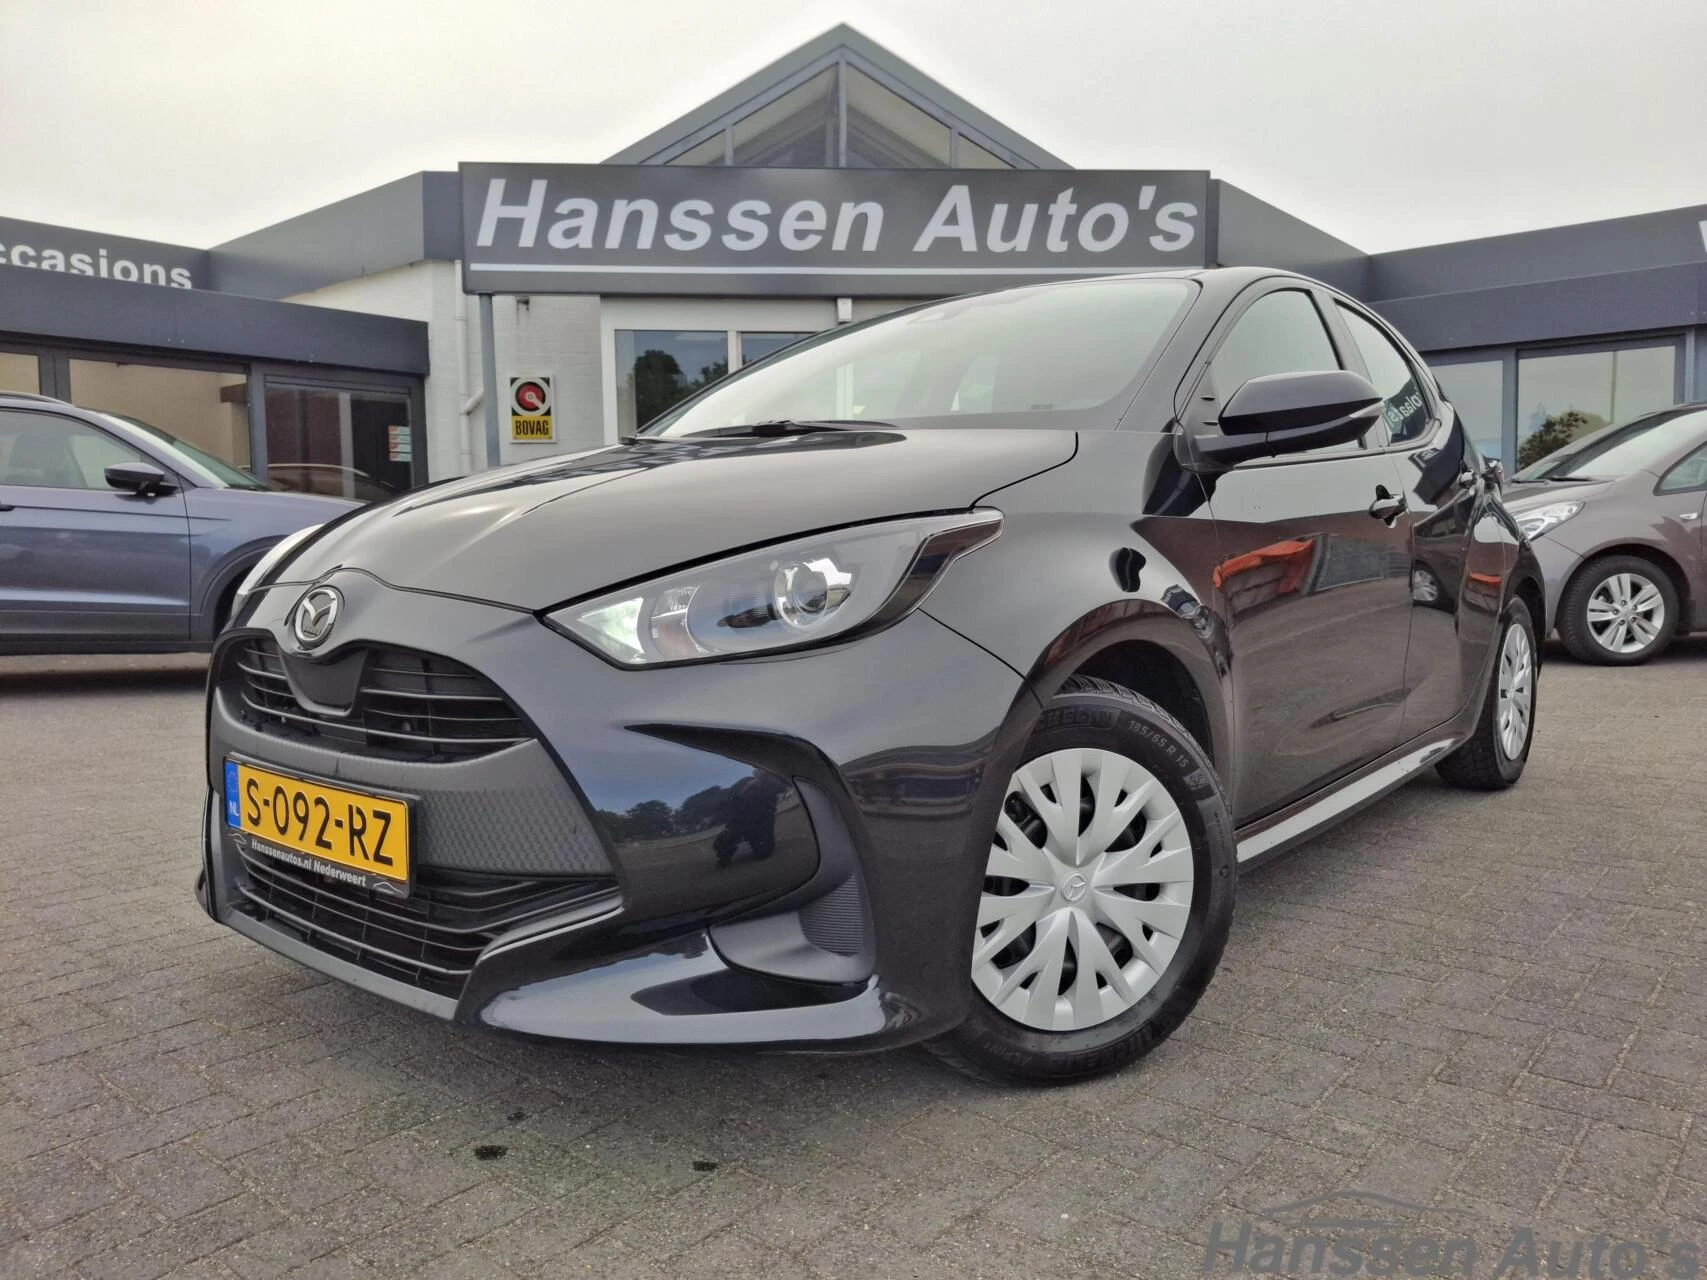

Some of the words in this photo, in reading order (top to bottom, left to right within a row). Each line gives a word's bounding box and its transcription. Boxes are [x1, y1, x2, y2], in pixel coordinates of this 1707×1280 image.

[476, 178, 884, 252] Hanssen
[912, 184, 1198, 253] Auto's
[0, 241, 193, 290] casions
[515, 420, 549, 436] BOVAG
[229, 800, 239, 817] NL
[246, 777, 394, 867] S-092-RZ
[251, 838, 312, 871] Hanssenautos.nl
[313, 860, 367, 887] Nederweert
